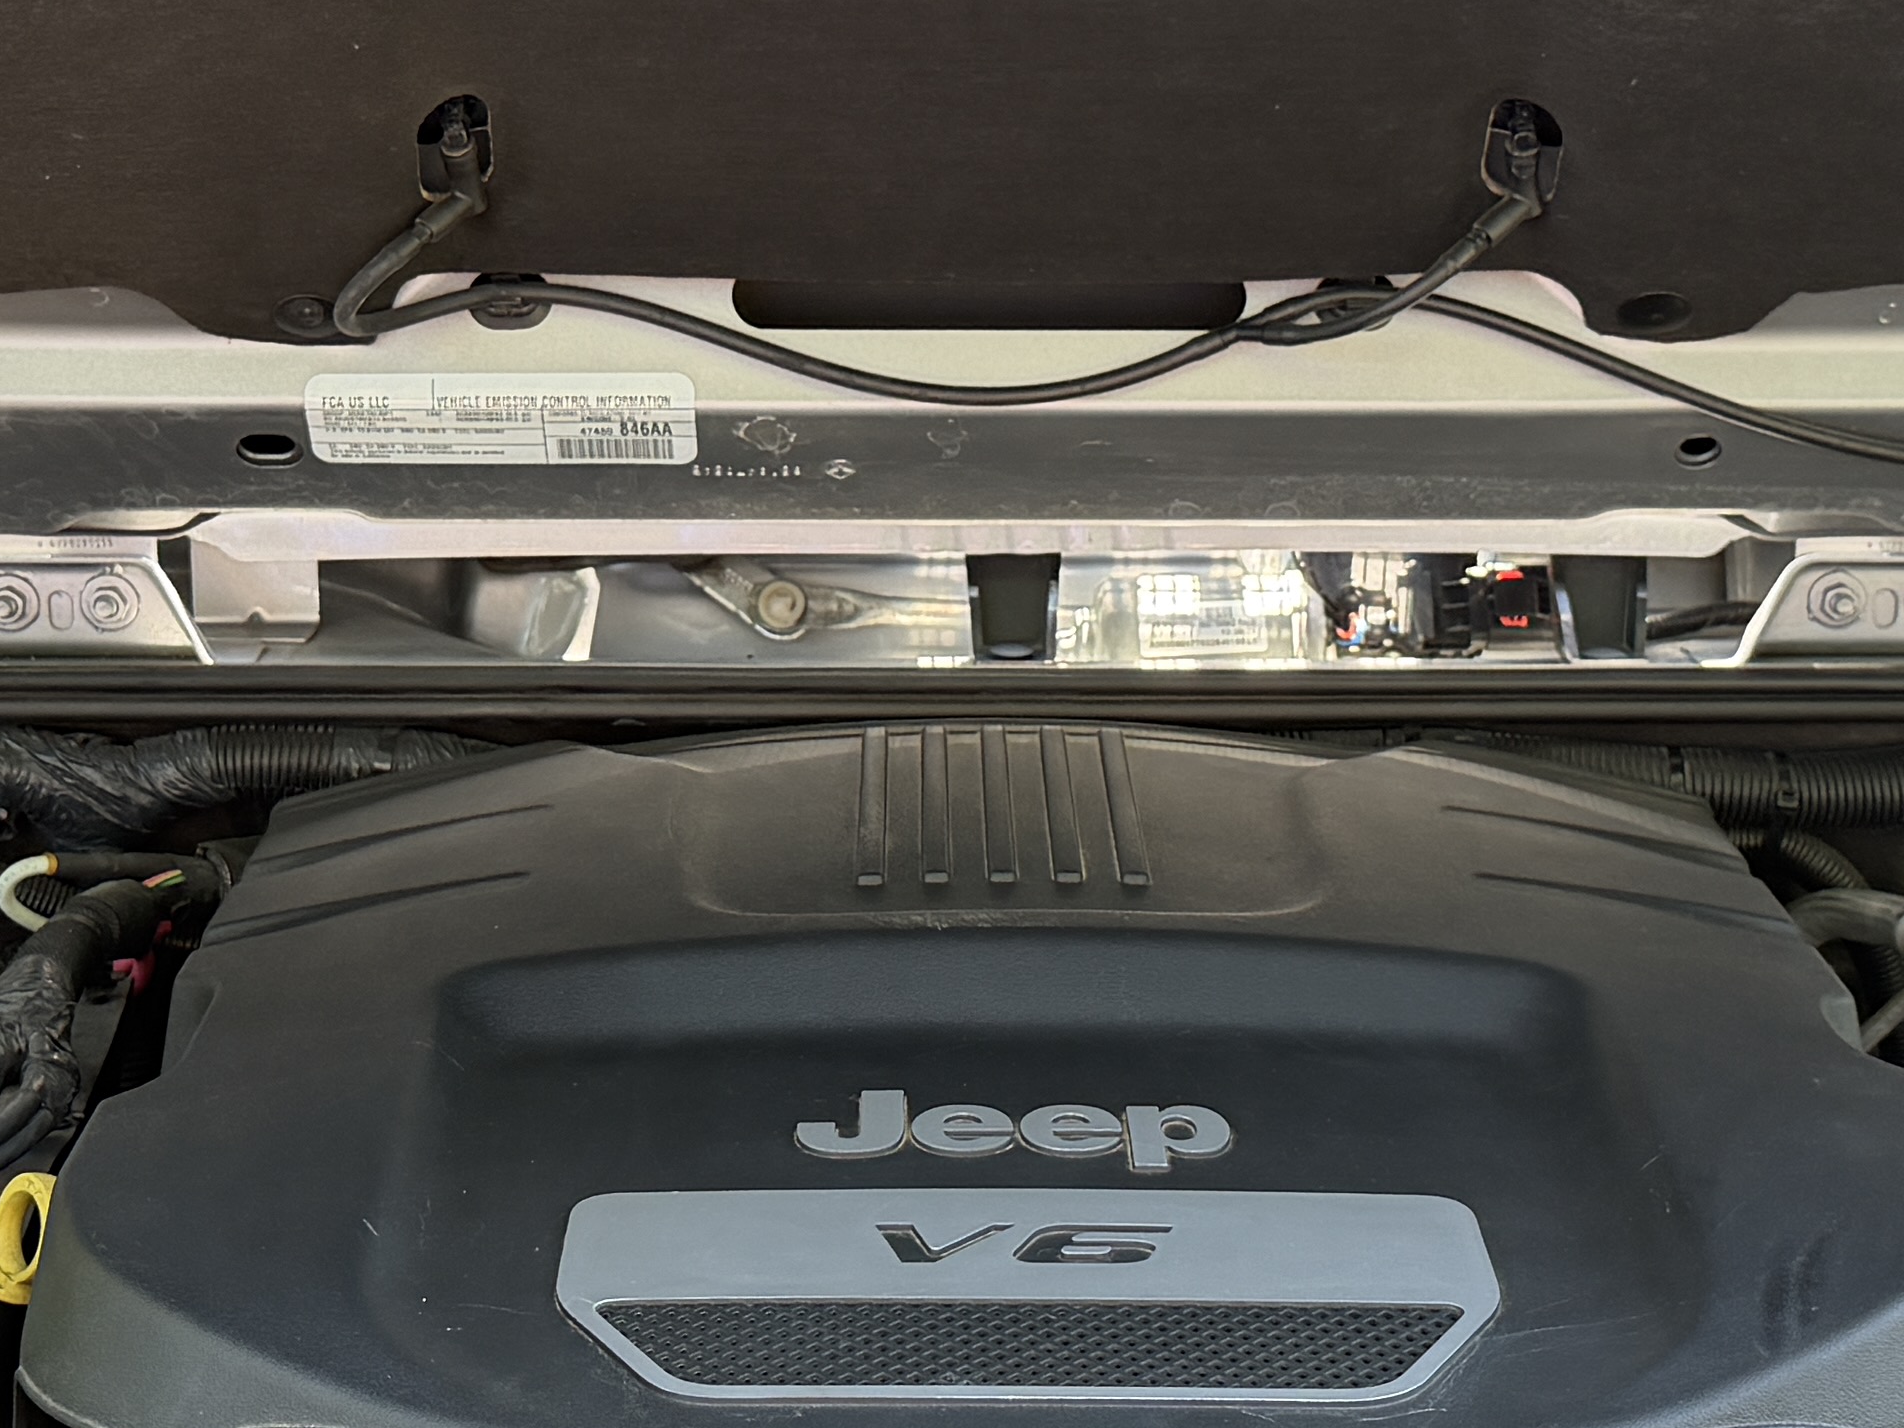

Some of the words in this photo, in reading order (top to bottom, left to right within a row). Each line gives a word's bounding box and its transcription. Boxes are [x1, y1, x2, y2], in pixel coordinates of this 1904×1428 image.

[322, 396, 344, 409] FCA
[348, 396, 365, 409] US
[368, 396, 390, 409] LLC
[436, 395, 481, 409] VEHICLE
[485, 395, 537, 408] EMISSION
[542, 395, 591, 408] CONTROL
[596, 395, 672, 408] INFORMATION
[619, 421, 673, 437] 846AA
[794, 1088, 1233, 1171] Jeep
[875, 1222, 1175, 1264] V6
